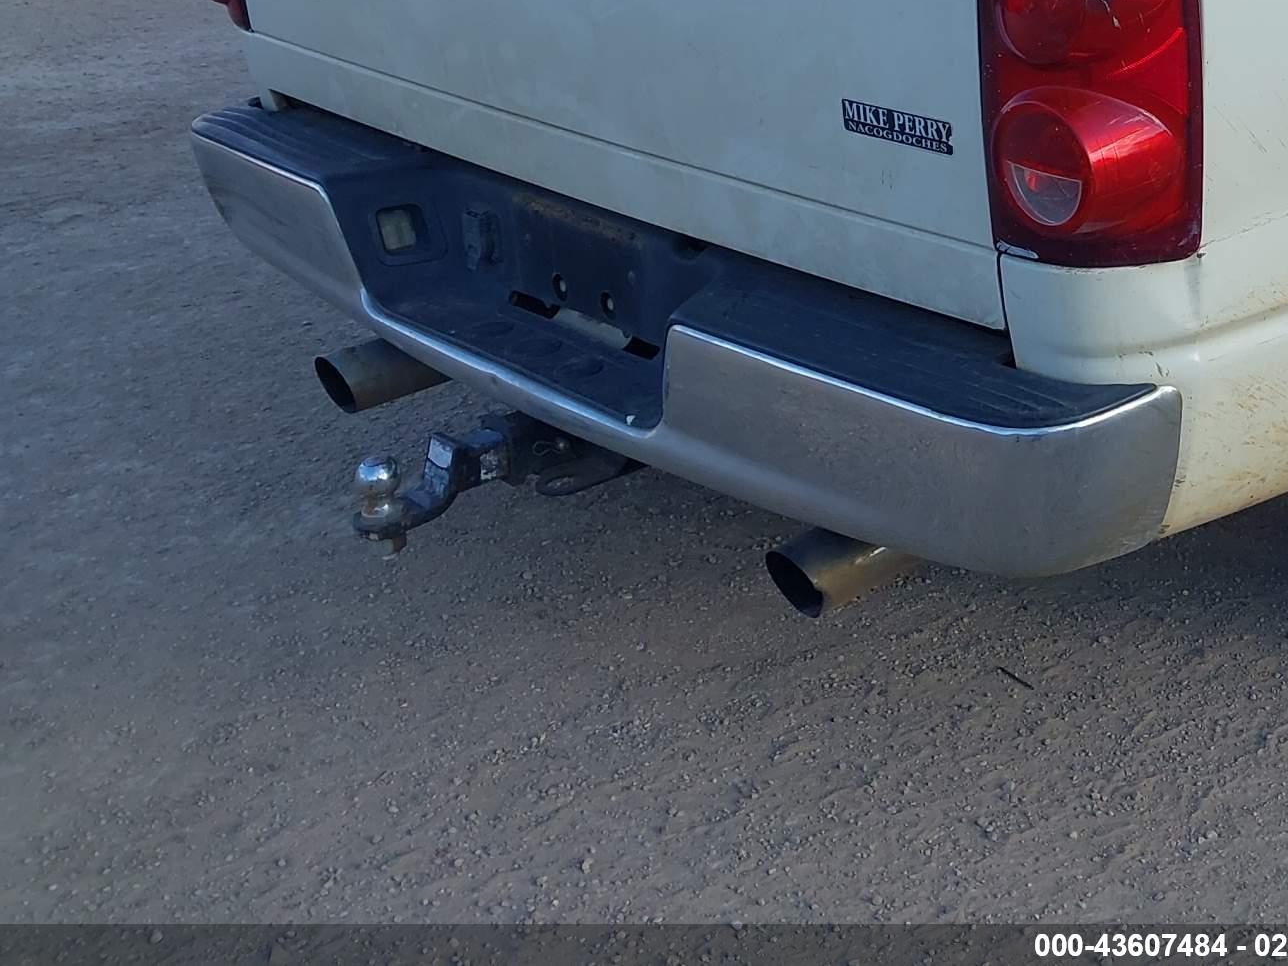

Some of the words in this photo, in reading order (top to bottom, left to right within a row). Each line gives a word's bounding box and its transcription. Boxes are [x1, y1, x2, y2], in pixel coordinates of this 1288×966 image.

[844, 100, 889, 129] MIKE
[893, 112, 950, 143] PERRY
[848, 120, 948, 153] NACOGDOCHES
